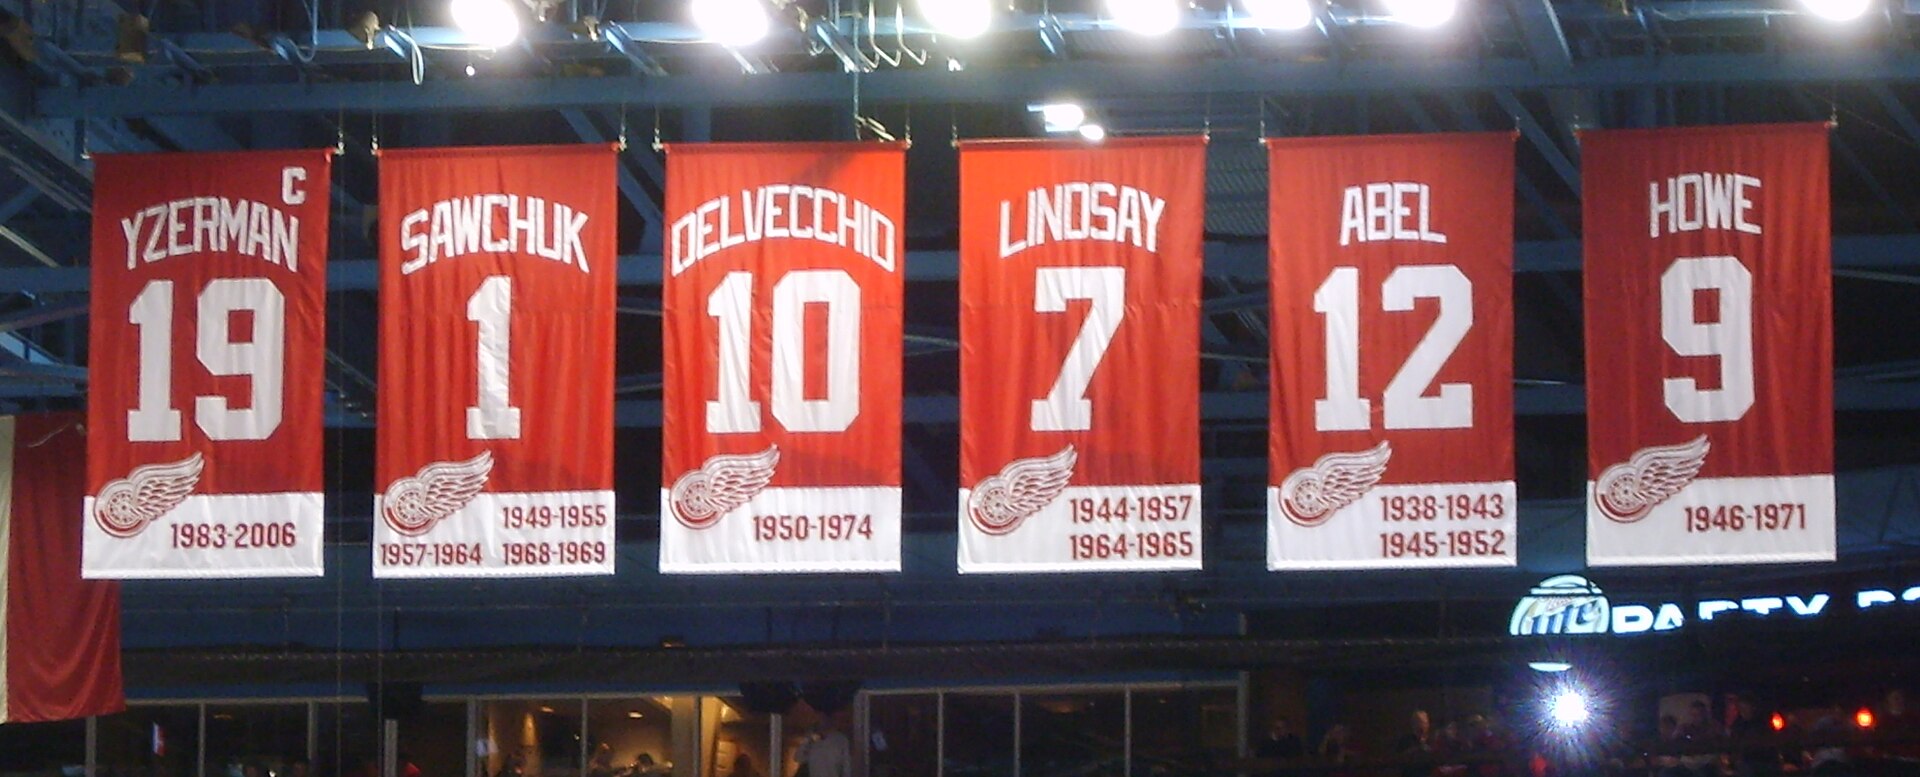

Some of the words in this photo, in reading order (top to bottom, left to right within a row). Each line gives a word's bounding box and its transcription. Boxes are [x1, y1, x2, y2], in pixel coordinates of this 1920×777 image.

[283, 168, 306, 204] C
[1339, 182, 1447, 246] ABEL
[1650, 172, 1762, 238] HOWE
[122, 197, 299, 273] YZERMAN
[402, 194, 590, 275] SAWCHUK
[671, 184, 895, 277] DELVECCHIO
[1000, 182, 1165, 258] LINDSAY
[128, 278, 285, 442] 19
[467, 275, 521, 440] 1
[706, 269, 861, 433] 10
[1031, 266, 1126, 431] 7
[1313, 265, 1474, 432] 12
[1661, 256, 1755, 423] 9
[170, 522, 297, 550] 1983-2006
[502, 505, 607, 529] 1949-1955
[753, 515, 873, 543] 1950-1974
[1070, 496, 1192, 523] 1944-1957
[1380, 495, 1505, 522] 1938-1943
[1684, 504, 1807, 533] 1946-1971
[380, 543, 483, 566] 1957-1964
[503, 541, 606, 566] 1968-1969
[1070, 532, 1194, 559] 1964-1965
[1379, 531, 1506, 558] 1945-1952
